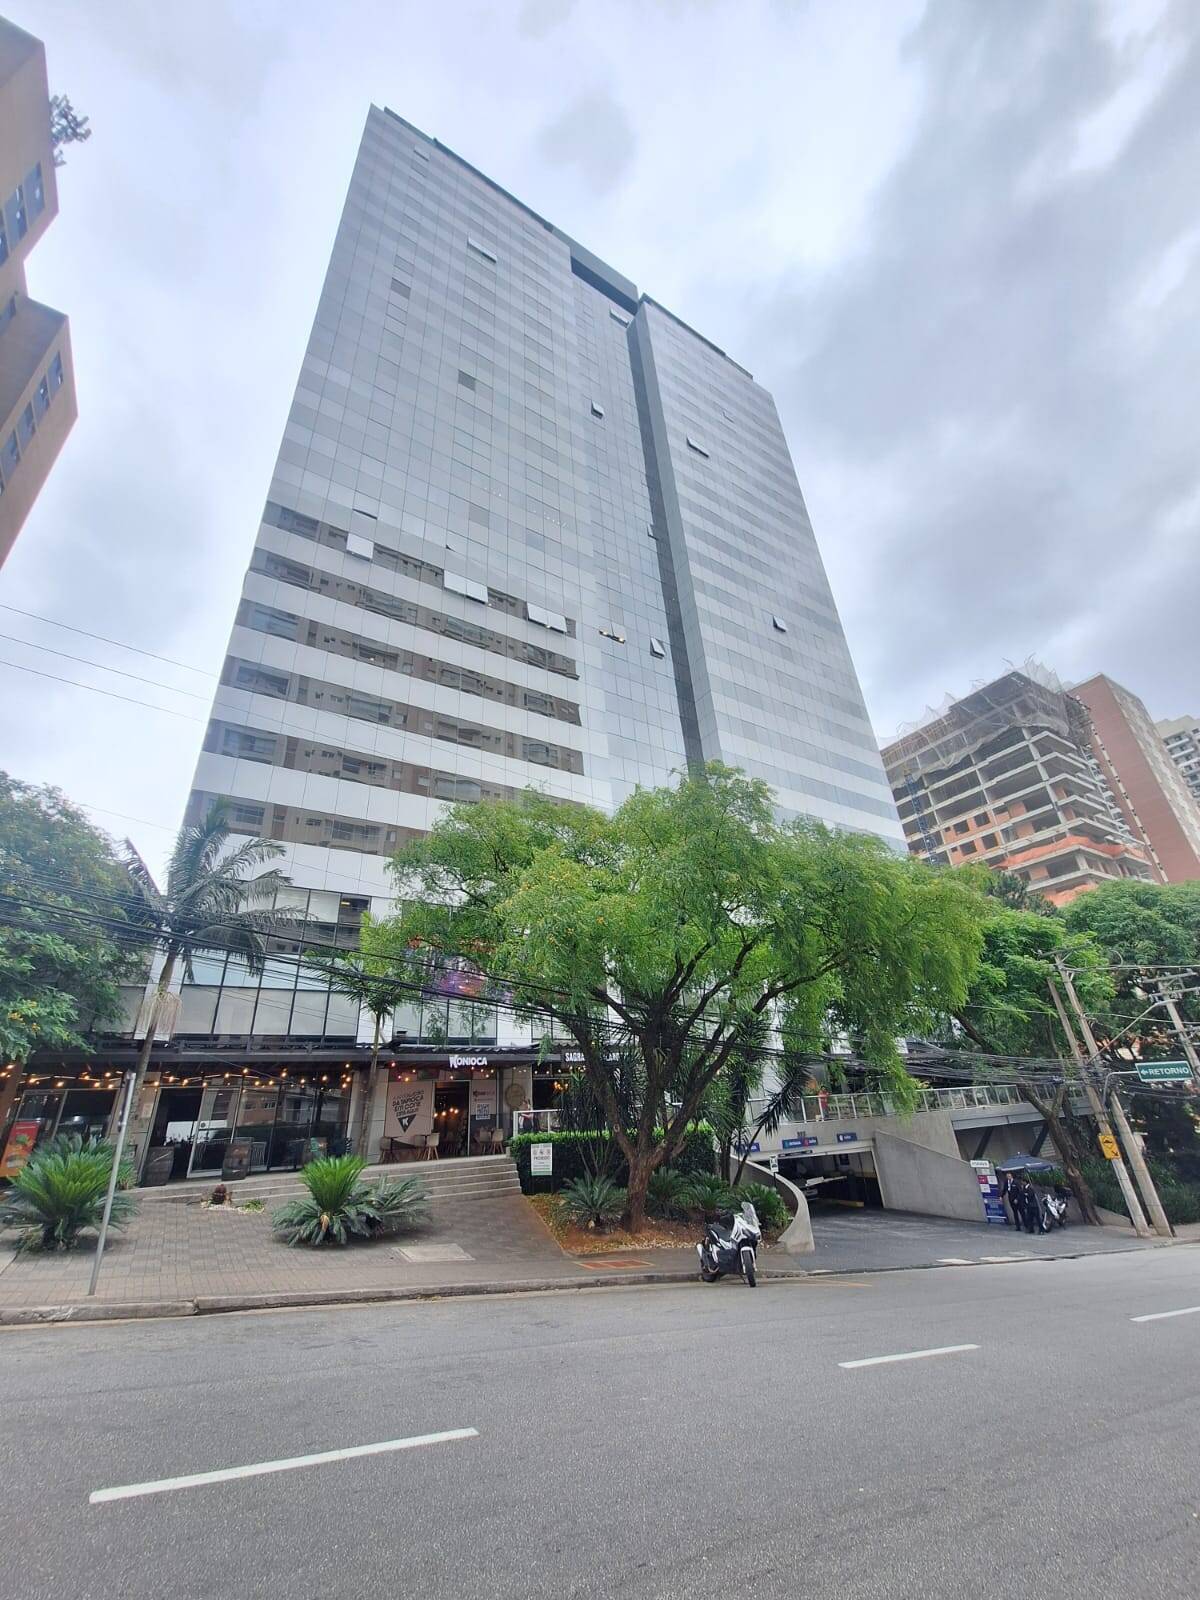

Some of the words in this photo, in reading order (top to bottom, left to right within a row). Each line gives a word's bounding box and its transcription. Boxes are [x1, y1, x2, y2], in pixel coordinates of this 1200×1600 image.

[565, 1053, 586, 1061] SAGRA
[449, 1055, 487, 1068] KONIOCA
[1148, 1067, 1189, 1075] RETORNO
